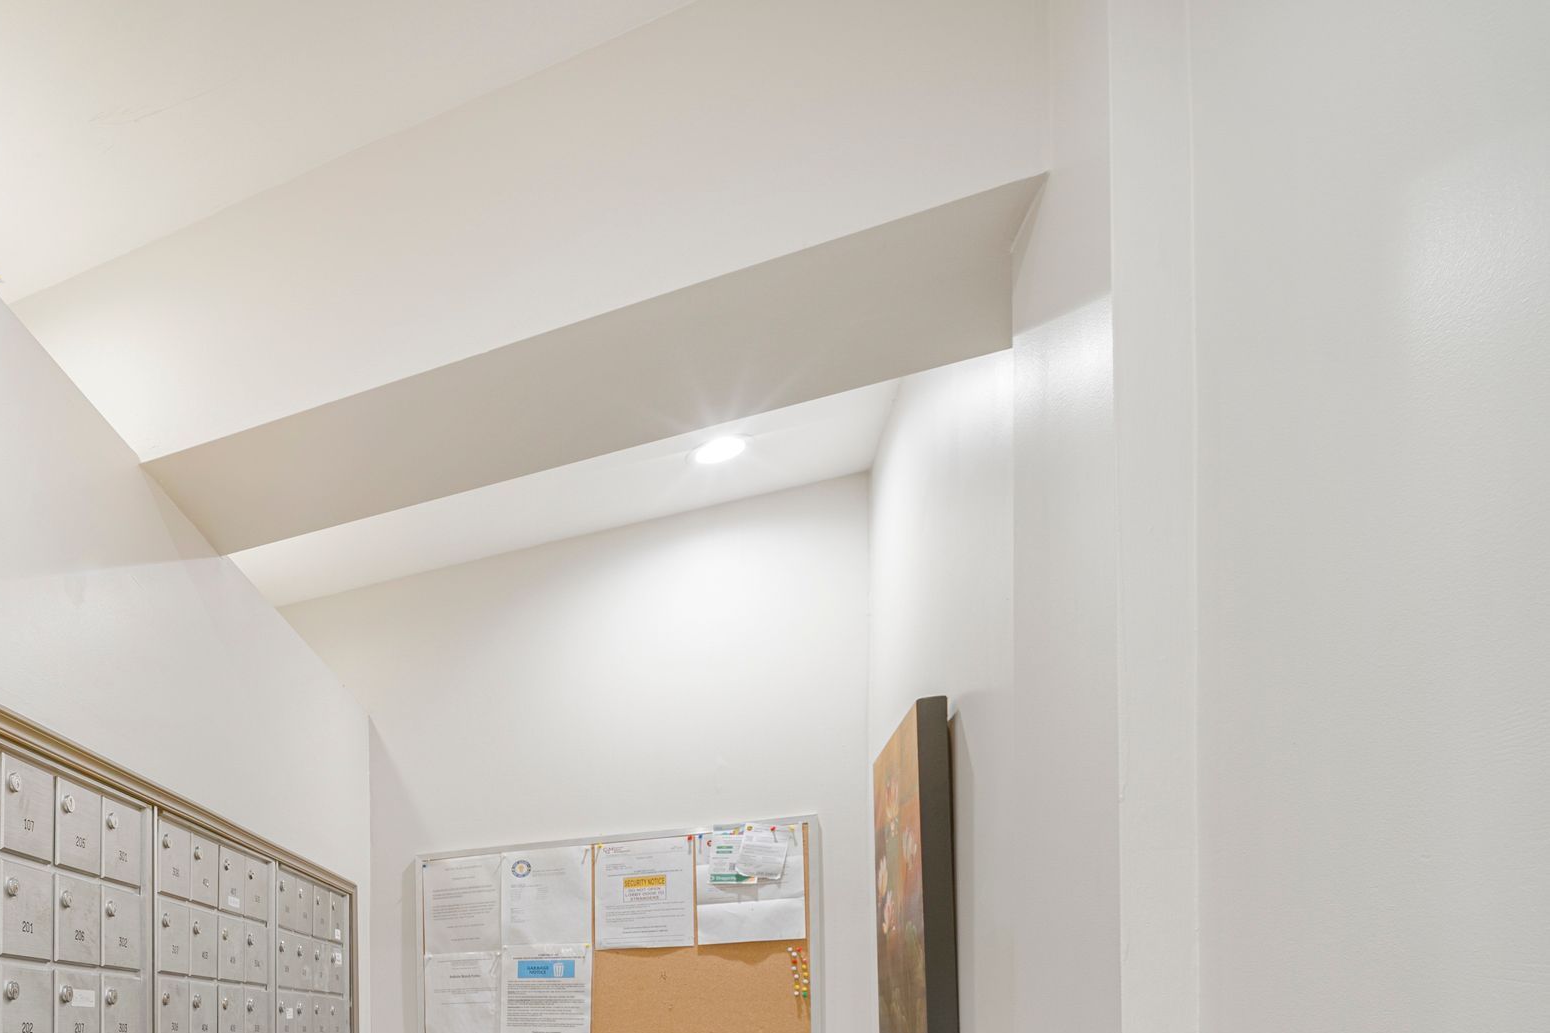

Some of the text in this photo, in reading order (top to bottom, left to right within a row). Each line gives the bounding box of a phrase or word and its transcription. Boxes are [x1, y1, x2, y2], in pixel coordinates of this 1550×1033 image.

[23, 818, 35, 832] 107
[75, 836, 86, 848] 205
[118, 850, 128, 863] 301
[22, 921, 34, 934] 201
[74, 930, 85, 942] 206
[118, 936, 128, 948] 302
[22, 1022, 34, 1033] 202
[74, 1022, 85, 1033] 207
